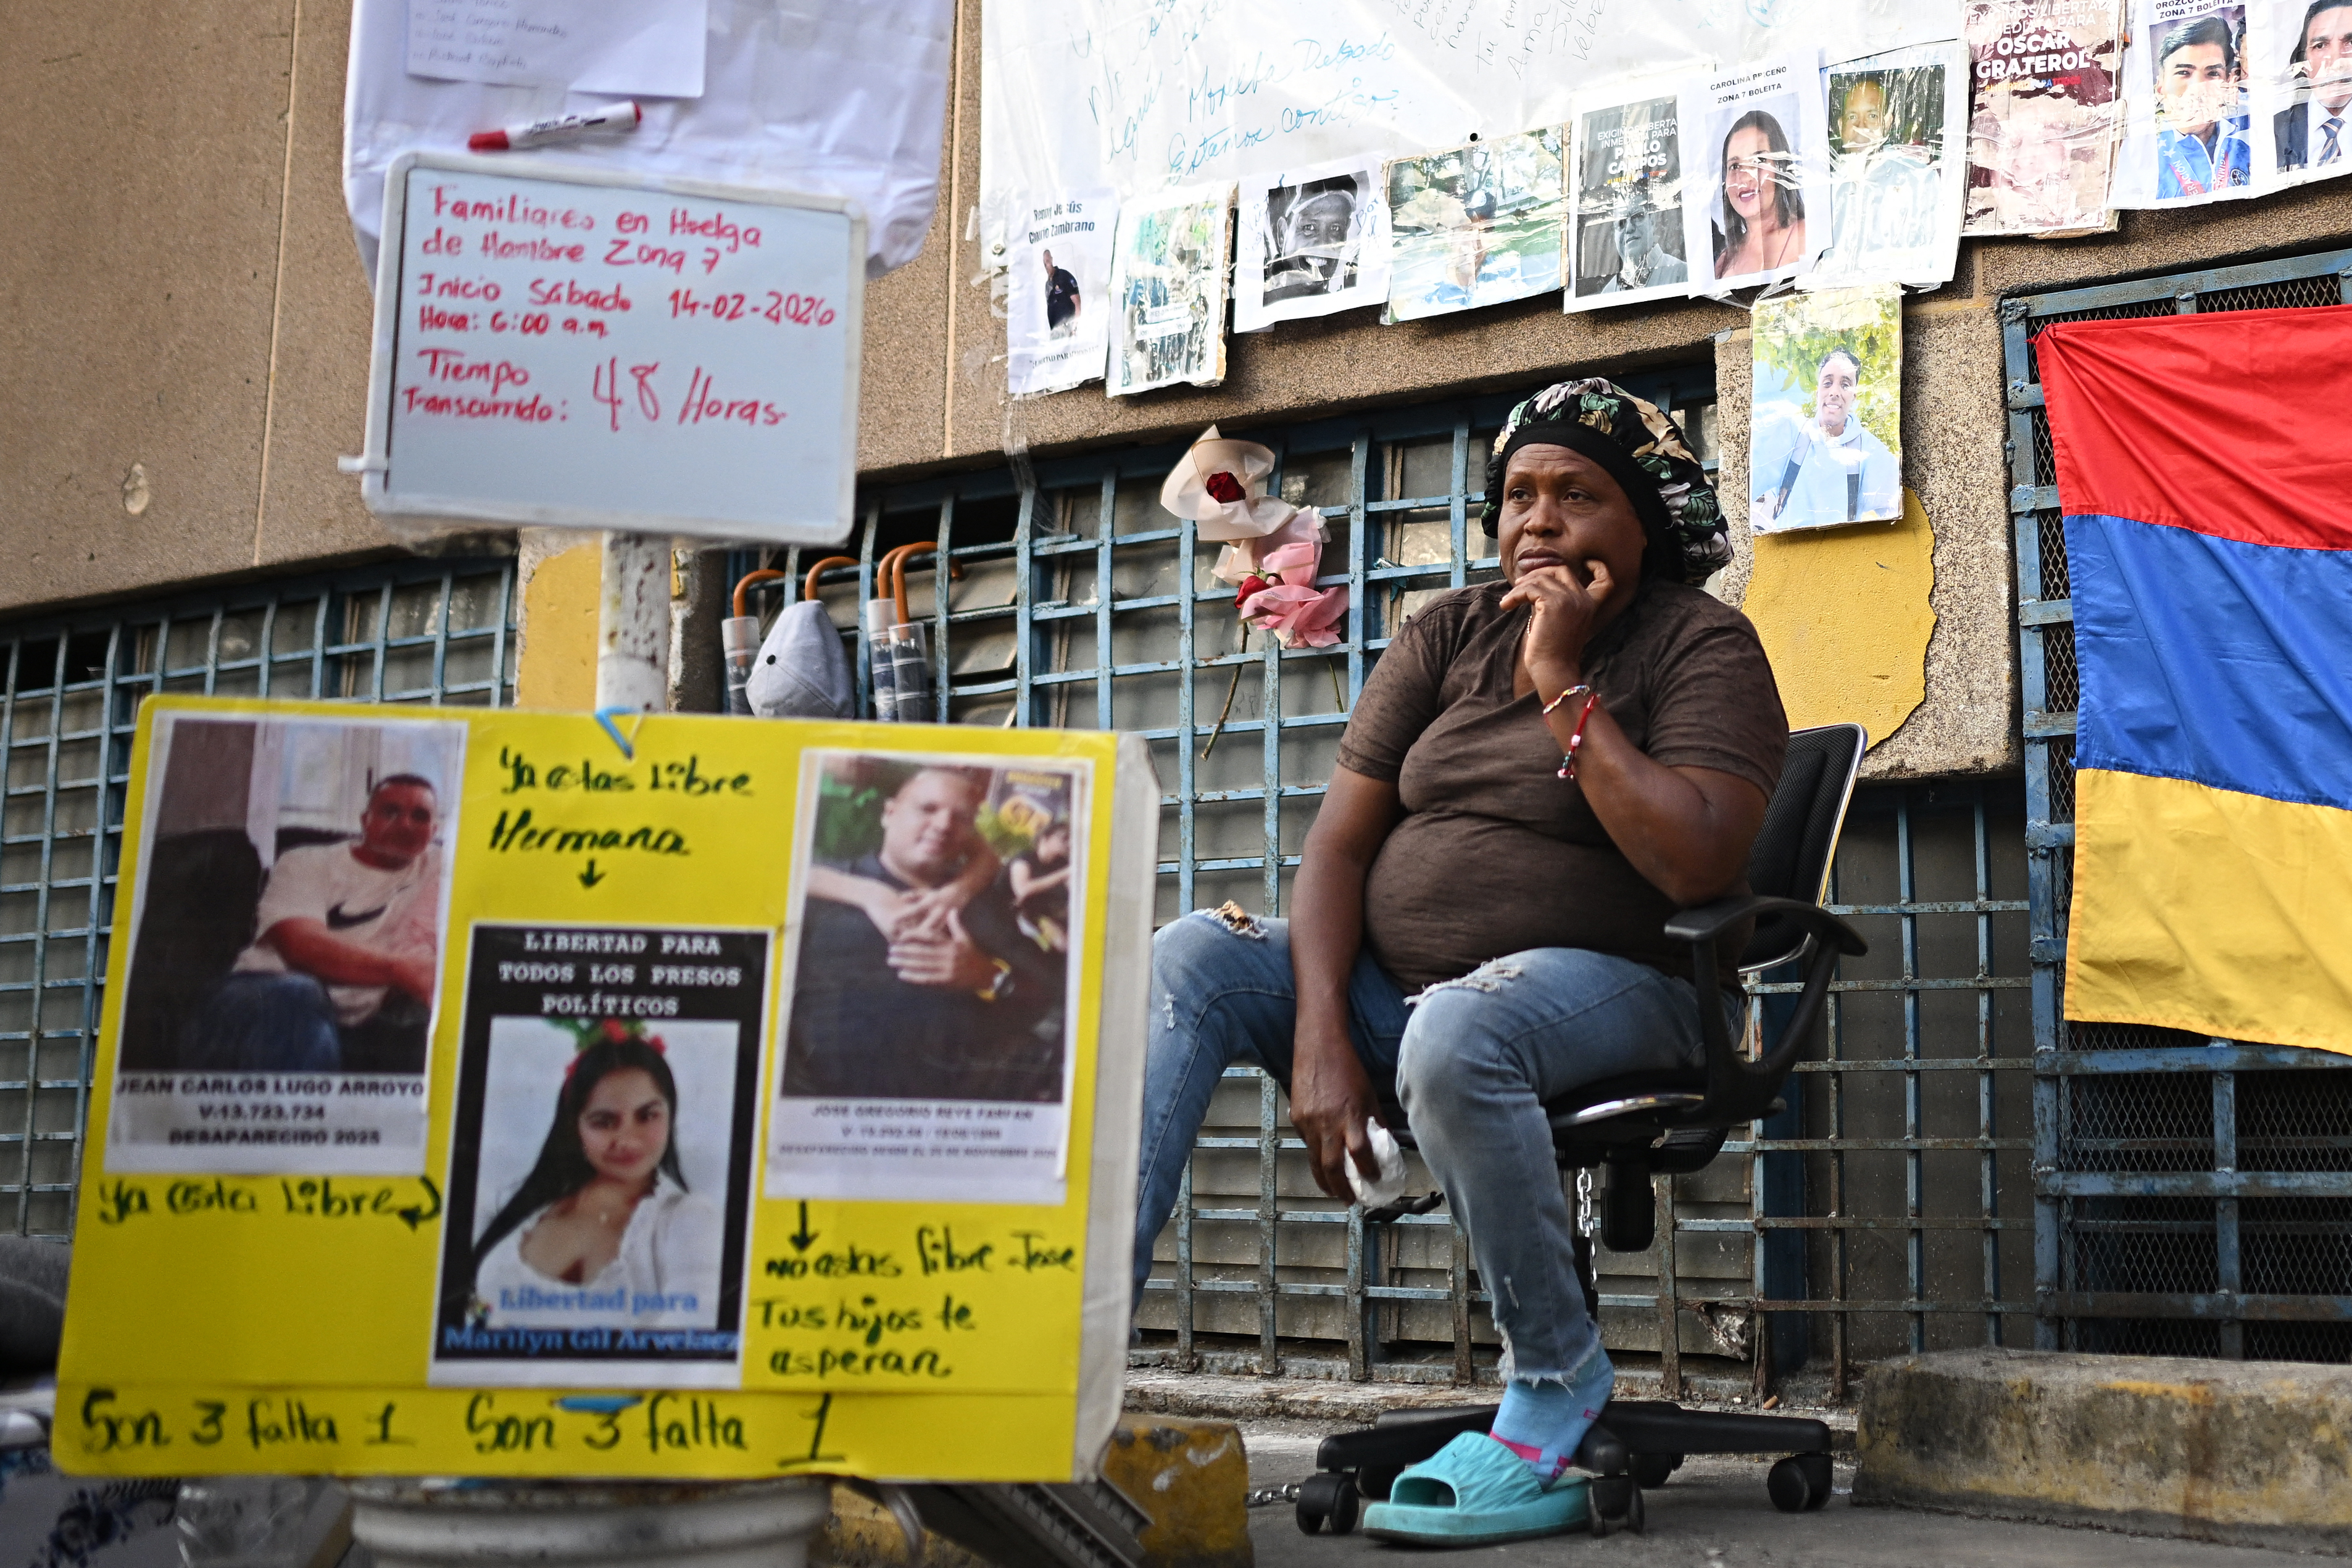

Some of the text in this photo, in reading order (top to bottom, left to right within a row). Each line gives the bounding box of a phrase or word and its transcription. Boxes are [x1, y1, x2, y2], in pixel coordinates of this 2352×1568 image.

[2160, 9, 2185, 19] ZONA
[1997, 31, 2071, 56] OSCAR
[1976, 51, 2090, 78] GRATEROL
[1710, 75, 1751, 91] CAROLINA
[1717, 83, 1782, 104] ZONA 7 BOLEITA
[1652, 127, 1677, 139] PARA
[430, 186, 762, 254] Familiares en Huelga
[1051, 221, 1095, 237] Zambrano
[422, 226, 463, 256] de
[603, 239, 686, 275] Zona
[702, 247, 721, 275] 7
[418, 273, 501, 301] Inicio
[668, 289, 837, 327] 14-02-2026
[489, 310, 551, 334] 6:00
[417, 348, 529, 396] Tiempo
[402, 386, 567, 425] Transcurrido:
[592, 356, 661, 432] 48
[525, 931, 721, 956] LIBERTAD PARA
[498, 961, 742, 987] TODOS LOS PRESOS
[541, 990, 679, 1016] POLÍTICOS
[116, 1079, 424, 1096] JEAN CARLOS LUGO ARROYO
[168, 1129, 328, 1146] DESAPARECIDO
[631, 1290, 698, 1316] para
[936, 1293, 976, 1330] te
[189, 1400, 227, 1445] 3
[363, 1401, 416, 1448] 1
[465, 1390, 846, 1468] Son 3 falta 1
